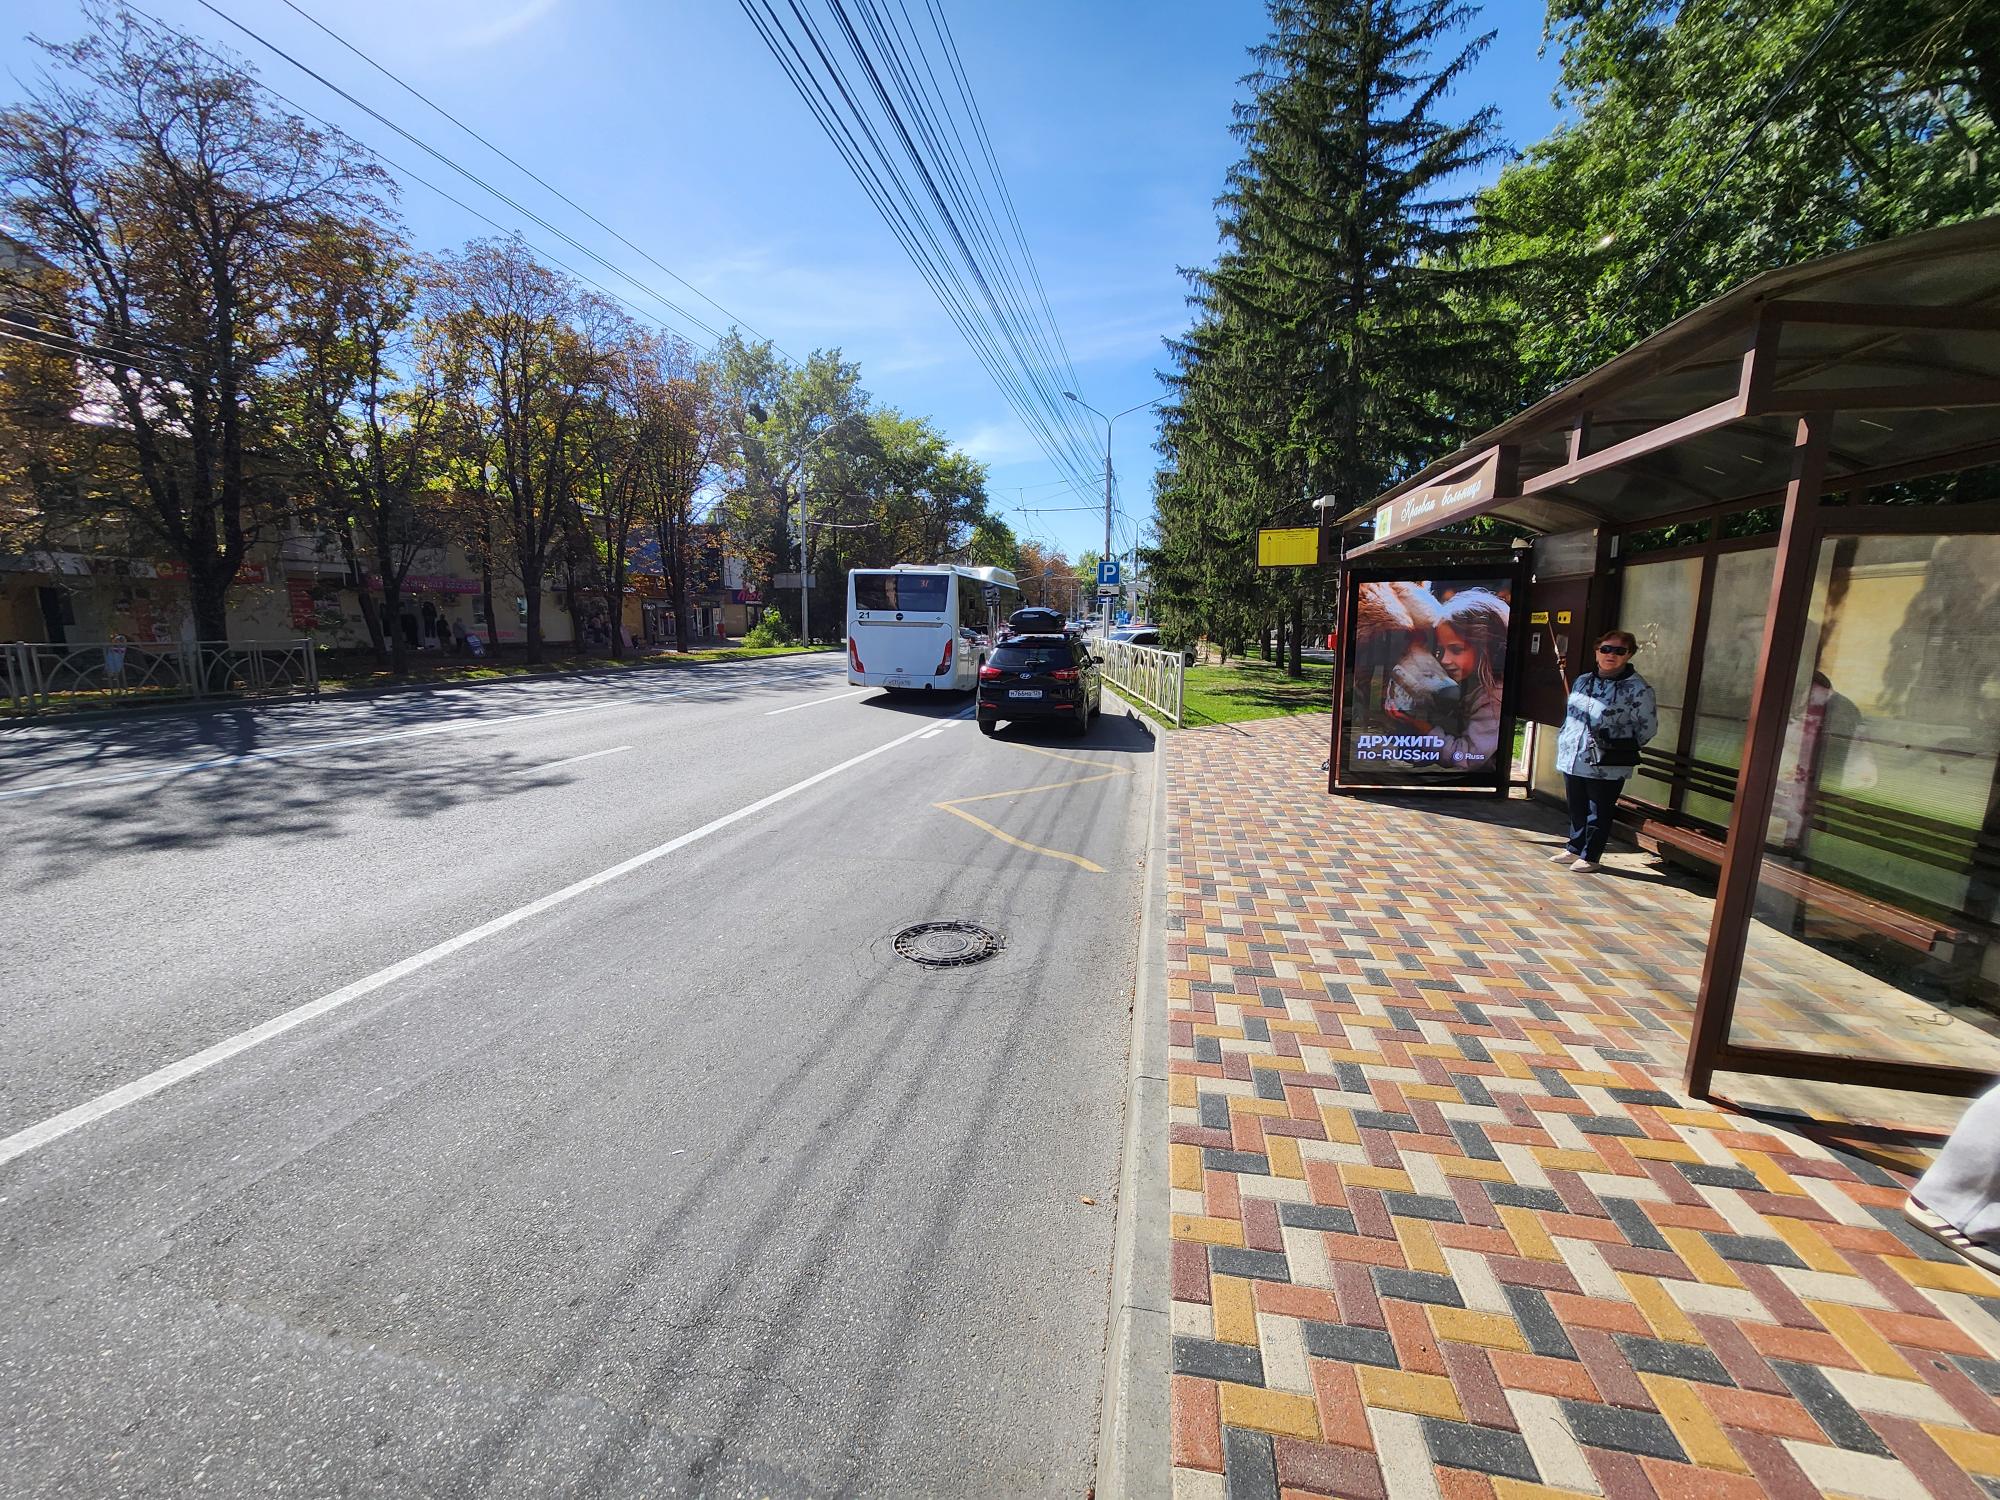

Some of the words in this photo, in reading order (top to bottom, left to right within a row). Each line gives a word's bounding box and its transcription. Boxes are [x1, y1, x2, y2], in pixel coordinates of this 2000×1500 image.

[1401, 494, 1436, 526] Краевая
[1441, 479, 1482, 506] больница
[1103, 564, 1117, 582] P
[1357, 735, 1445, 748] ДРУЖИТЬ
[1357, 749, 1440, 760] по-RUSSки
